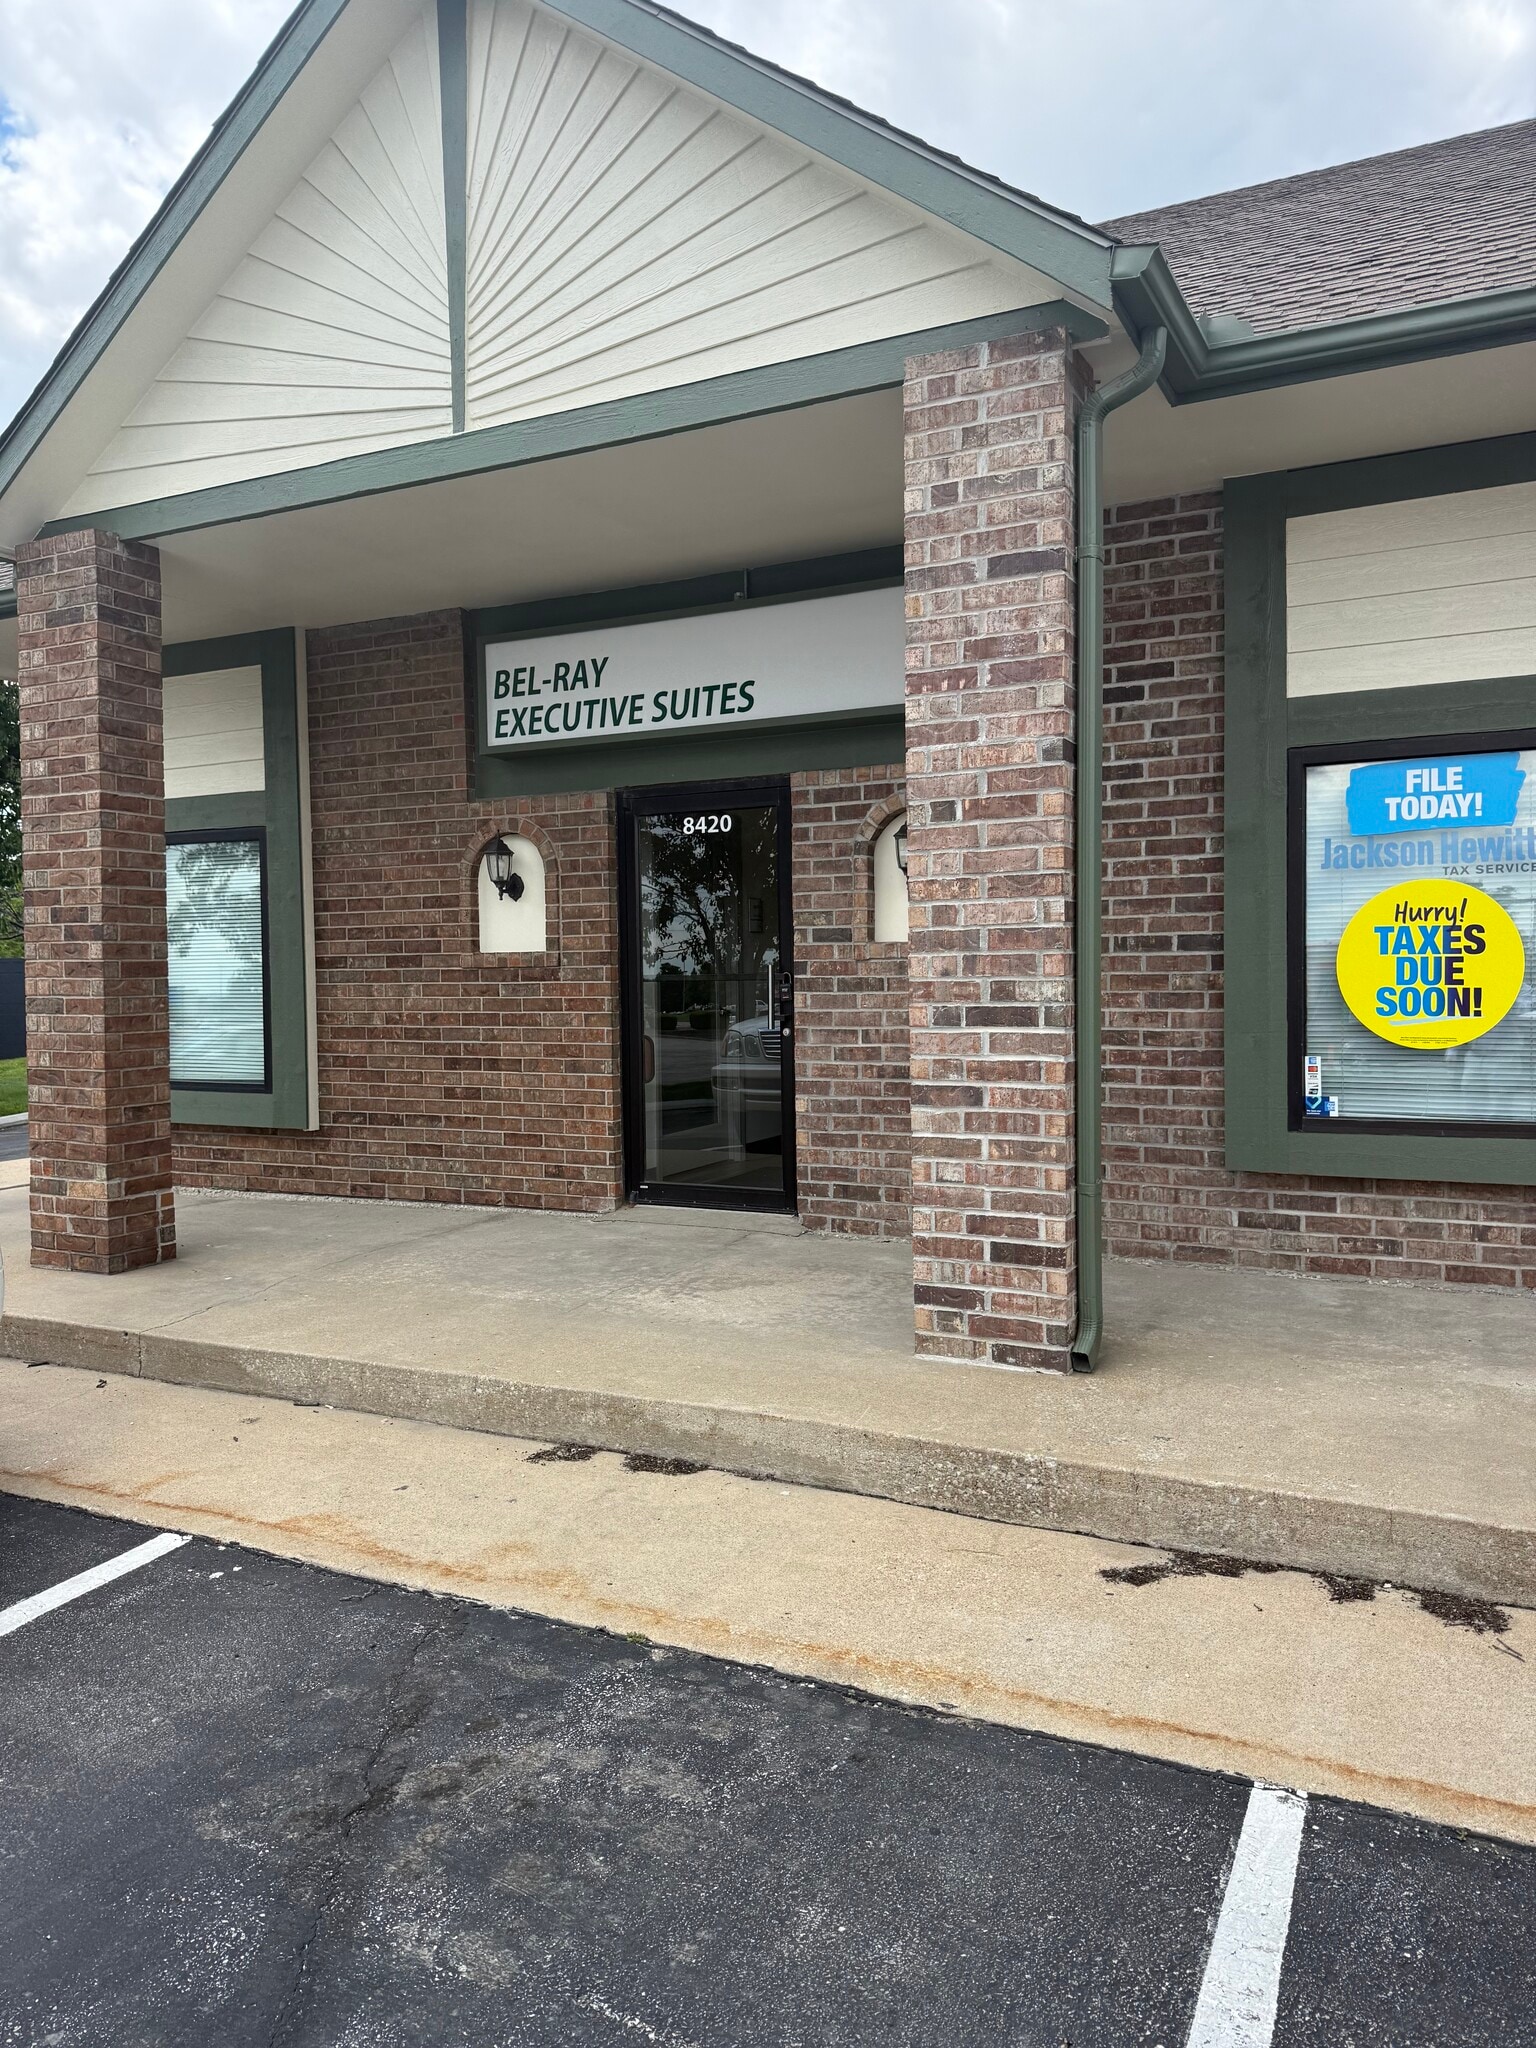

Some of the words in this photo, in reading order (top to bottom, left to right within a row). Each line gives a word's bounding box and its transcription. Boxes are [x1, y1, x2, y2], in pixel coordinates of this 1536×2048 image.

[494, 657, 608, 699] BEL-RAY
[494, 693, 645, 738] EXECUTIVE
[651, 680, 755, 723] SUITES
[1406, 767, 1462, 792] FILE
[1384, 792, 1483, 821] TODAY!
[682, 814, 732, 835] 8420
[1321, 838, 1434, 869] Jackson
[1442, 865, 1470, 876] TAX
[1394, 898, 1467, 927] Hurry!
[1374, 924, 1486, 955] TAXES
[1396, 956, 1465, 986] DUE
[1375, 987, 1483, 1017] SOON!
